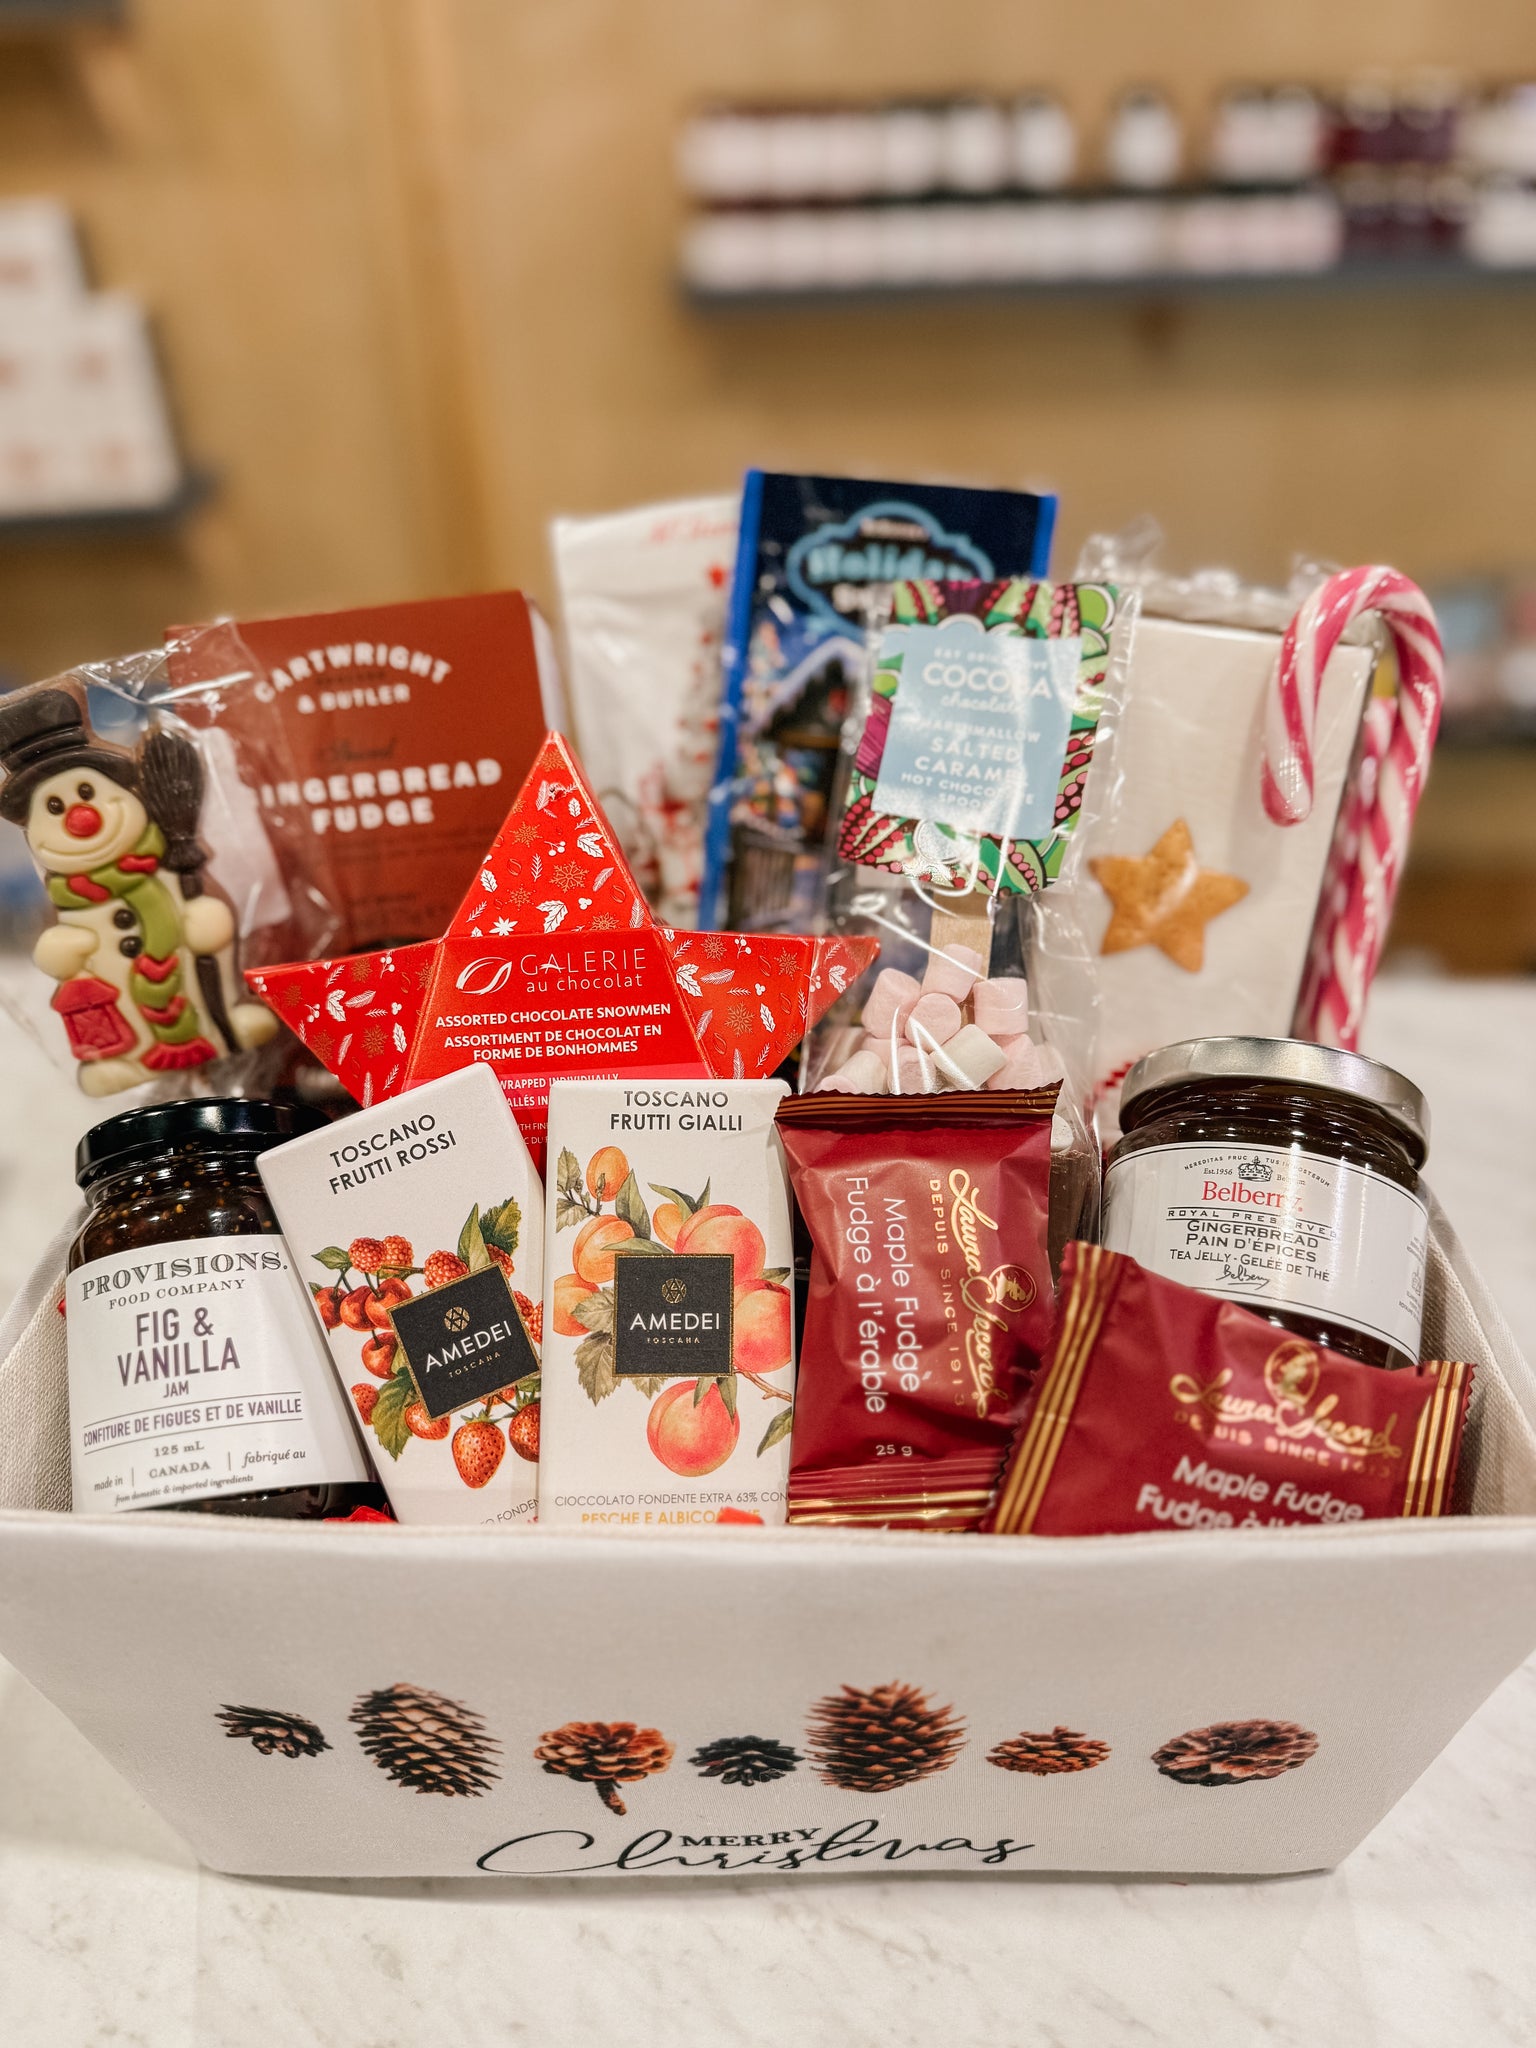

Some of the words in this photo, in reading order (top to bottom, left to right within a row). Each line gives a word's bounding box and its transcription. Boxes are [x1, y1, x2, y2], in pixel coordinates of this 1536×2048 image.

[254, 642, 452, 703] CARTWRIGHT
[922, 661, 1054, 700] COCOA
[320, 683, 411, 711] BUTLER
[931, 737, 1021, 763] SALTED
[914, 755, 1029, 788] CARAME
[900, 772, 933, 787] HOT
[938, 778, 1036, 806] CHOCOE
[937, 793, 992, 810] SPOO
[311, 797, 434, 835] FUDGE
[520, 948, 647, 976] GALERIE
[526, 981, 549, 993] au
[556, 973, 644, 992] chocolat
[435, 1012, 508, 1028] ASSORTED
[510, 1007, 594, 1024] CHOCOLATE
[596, 1003, 672, 1019] SNOWMEN
[444, 1031, 542, 1048] ASSORTIMENT
[544, 1029, 563, 1042] DE
[565, 1025, 641, 1041] CHOCOLAT
[643, 1024, 663, 1037] EN
[473, 1047, 522, 1061] FORME
[525, 1045, 543, 1058] DE
[546, 1040, 638, 1057] BONHOMMES
[500, 1077, 547, 1090] WRAPPED
[624, 1090, 729, 1108] TOSCANO
[610, 1113, 671, 1131] FRUTTI
[678, 1114, 743, 1132] GIALLI
[330, 1114, 436, 1168] TOSCANO
[328, 1156, 393, 1195] FRUTTI
[396, 1130, 457, 1167] ROSSI
[1294, 1166, 1331, 1188] OSTERUM
[845, 1176, 873, 1264] Fudge
[948, 1168, 999, 1279] Laura
[1168, 1210, 1219, 1218] ROYAL
[1232, 1213, 1338, 1238] PRESRVED
[1187, 1220, 1319, 1249] GINGERBREAD
[882, 1196, 915, 1288] Maple
[928, 1178, 949, 1255] DEPUIS
[940, 1267, 959, 1333] SINCE
[1186, 1233, 1228, 1248] PAIN
[1234, 1237, 1317, 1263] D'ÉPICES
[82, 1251, 288, 1302] PROVISIONS.
[855, 1271, 877, 1293] à
[1170, 1249, 1191, 1260] TEA
[1194, 1250, 1231, 1263] JELLY
[1286, 1263, 1303, 1276] DE
[1305, 1265, 1330, 1282] THÉ
[109, 1290, 151, 1310] FOOD
[156, 1278, 246, 1300] COMPANY
[136, 1307, 180, 1347] FIG
[193, 1306, 214, 1337] &
[630, 1312, 720, 1331] AMEDEI
[424, 1320, 513, 1374] AMEDEI
[647, 1337, 701, 1345] TOSCANA
[857, 1301, 889, 1413] l'érable
[892, 1297, 923, 1393] Fudge
[959, 1274, 1009, 1419] Secord
[117, 1336, 241, 1388] VANILLA
[448, 1350, 502, 1379] TOSCANA
[163, 1380, 189, 1398] JAM
[83, 1420, 132, 1448] CONFITURE
[134, 1417, 150, 1434] DE
[153, 1408, 201, 1430] FIGUES
[206, 1405, 222, 1422] ET
[226, 1402, 244, 1419] DE
[248, 1397, 302, 1416] VANILLE
[1173, 1409, 1253, 1447] DEUIS
[1263, 1435, 1331, 1468] SINCE
[154, 1444, 179, 1458] 125
[183, 1440, 206, 1452] mL
[876, 1444, 896, 1456] 25
[901, 1445, 913, 1457] g
[94, 1474, 114, 1492] made
[114, 1475, 124, 1487] in
[150, 1460, 211, 1480] CANADA
[241, 1448, 291, 1469] fabriqué
[292, 1450, 307, 1459] au
[115, 1493, 130, 1507] from
[131, 1486, 163, 1502] domestic
[172, 1478, 209, 1495] imported
[210, 1474, 255, 1490] ingredients
[555, 1494, 635, 1507] CIOCCOLATO
[638, 1492, 697, 1505] FONDENTE
[699, 1492, 734, 1504] EXTRA
[736, 1491, 758, 1503] 63%
[1171, 1455, 1270, 1502] Maple
[1273, 1481, 1365, 1523] Fudge
[1135, 1483, 1234, 1530] Fudge
[476, 1818, 1035, 1874] Christmas
[679, 1824, 822, 1848] MERRY
